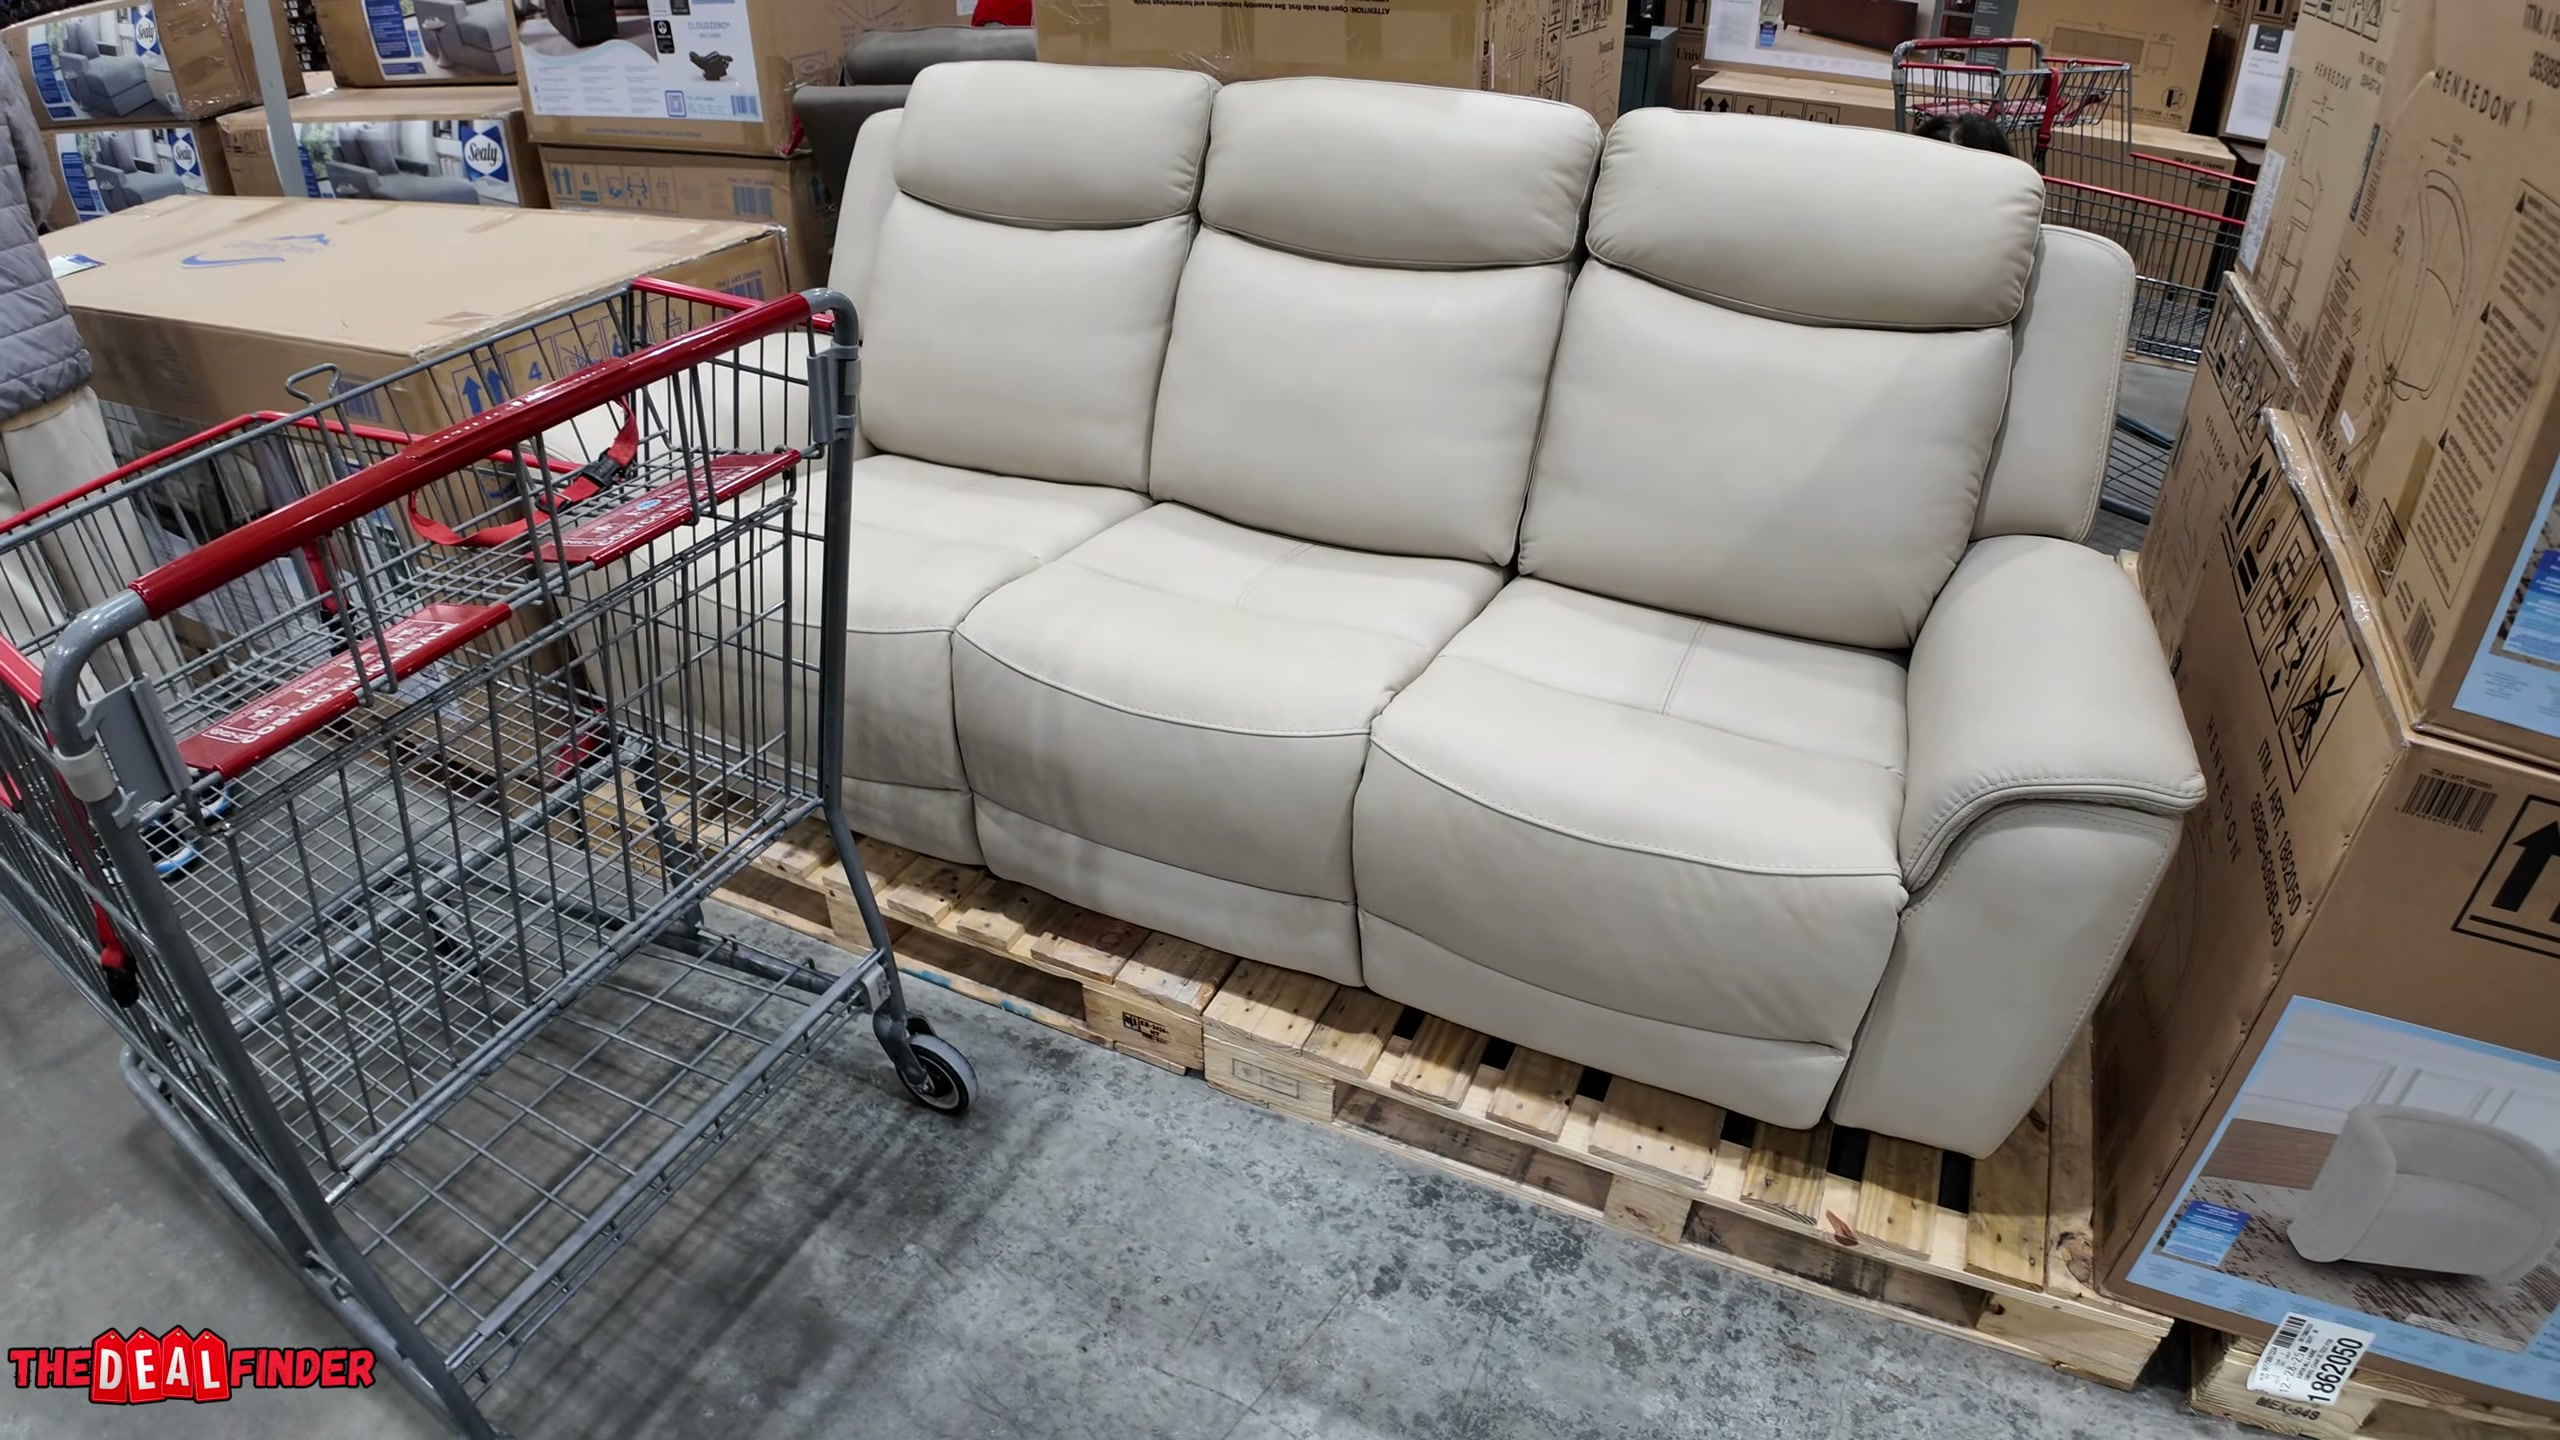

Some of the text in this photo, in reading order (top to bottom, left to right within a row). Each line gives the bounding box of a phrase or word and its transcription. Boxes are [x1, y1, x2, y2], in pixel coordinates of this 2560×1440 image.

[1331, 5, 1348, 13] Open
[137, 24, 155, 42] Sealy
[2433, 65, 2516, 128] HENREDON
[175, 146, 193, 165] Sealy
[468, 143, 498, 164] Sealy
[582, 172, 590, 186] 6
[528, 361, 542, 381] 4
[598, 512, 666, 546] COSTCO
[2256, 517, 2276, 554] 6
[241, 692, 332, 744] COSTCO
[2205, 715, 2242, 864] HENREDON
[2278, 831, 2302, 916] 1862050
[2279, 1351, 2304, 1393] 12-28-25
[2308, 1337, 2363, 1402] 1862050
